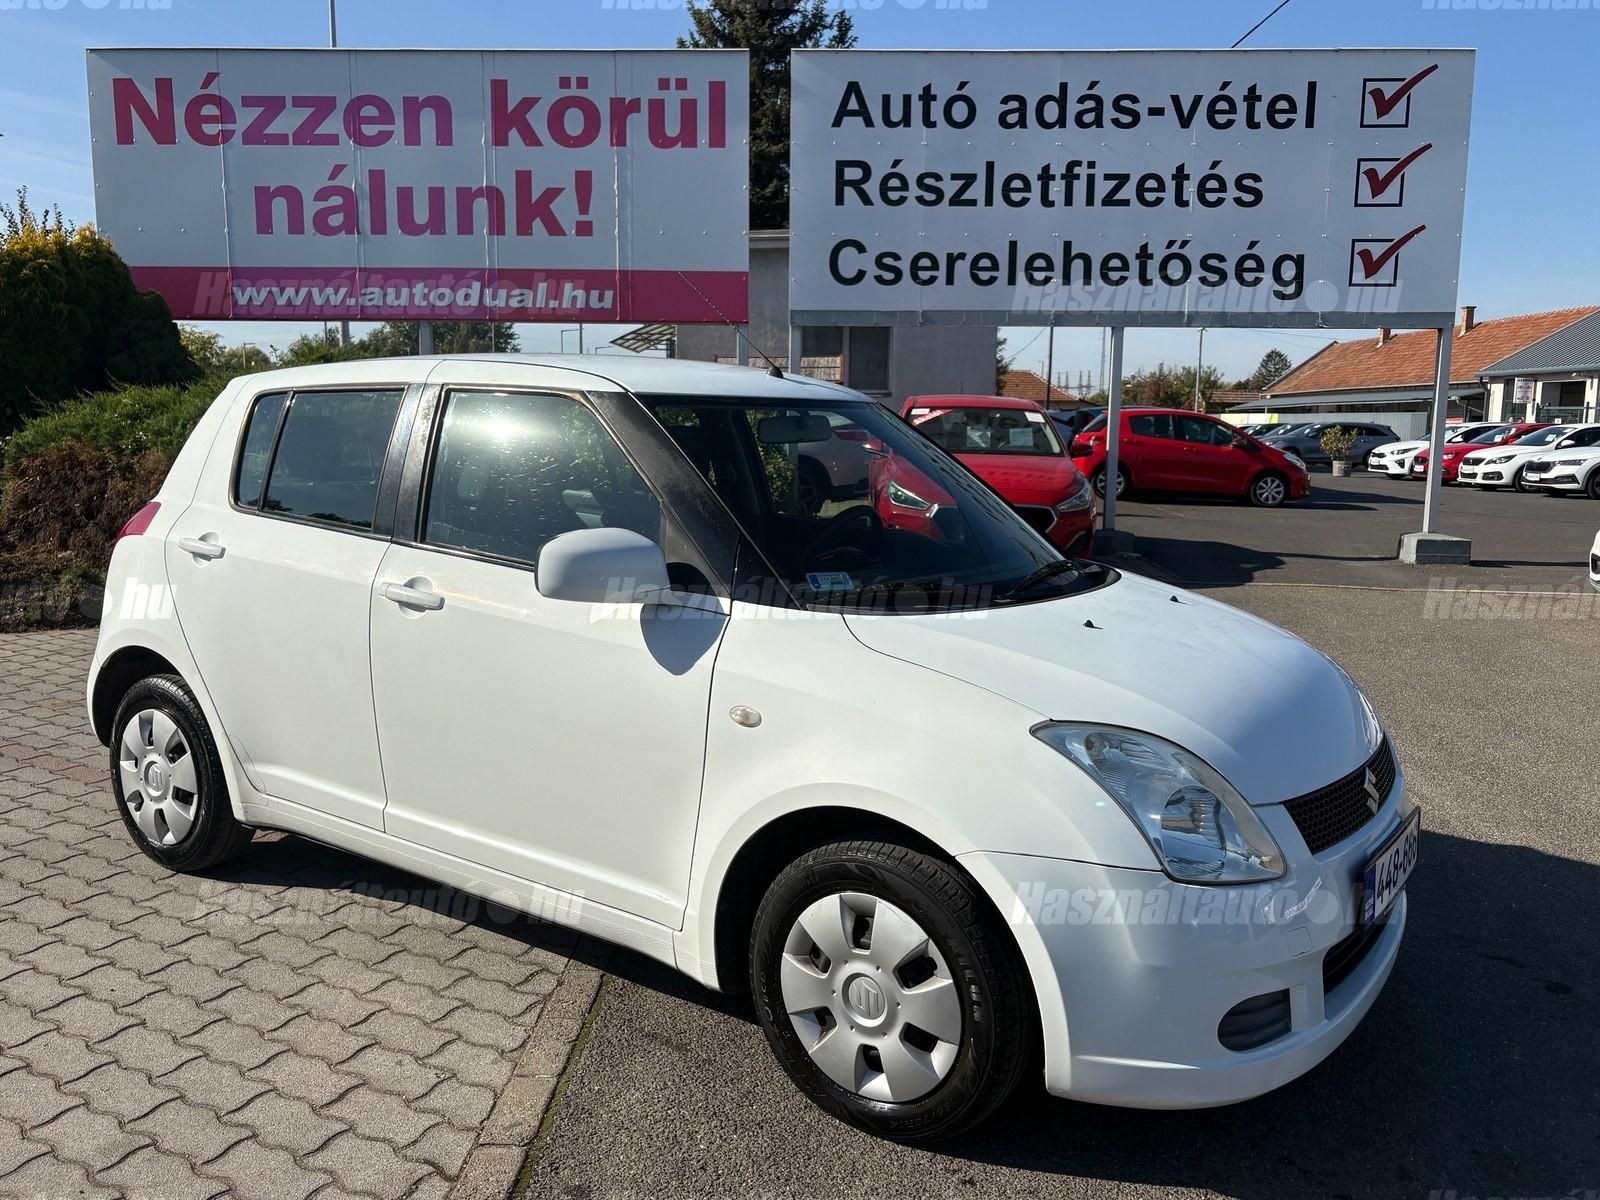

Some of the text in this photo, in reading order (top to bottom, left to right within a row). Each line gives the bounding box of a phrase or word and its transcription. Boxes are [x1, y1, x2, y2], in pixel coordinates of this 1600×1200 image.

[112, 72, 727, 150] Nézzen körül
[831, 79, 1318, 131] Autó adás-vétel
[254, 163, 593, 238] nálunk!
[834, 158, 1264, 209] Részletfizetés
[231, 279, 615, 309] www.autodual.hu
[828, 237, 1306, 301] Cserelehetőség
